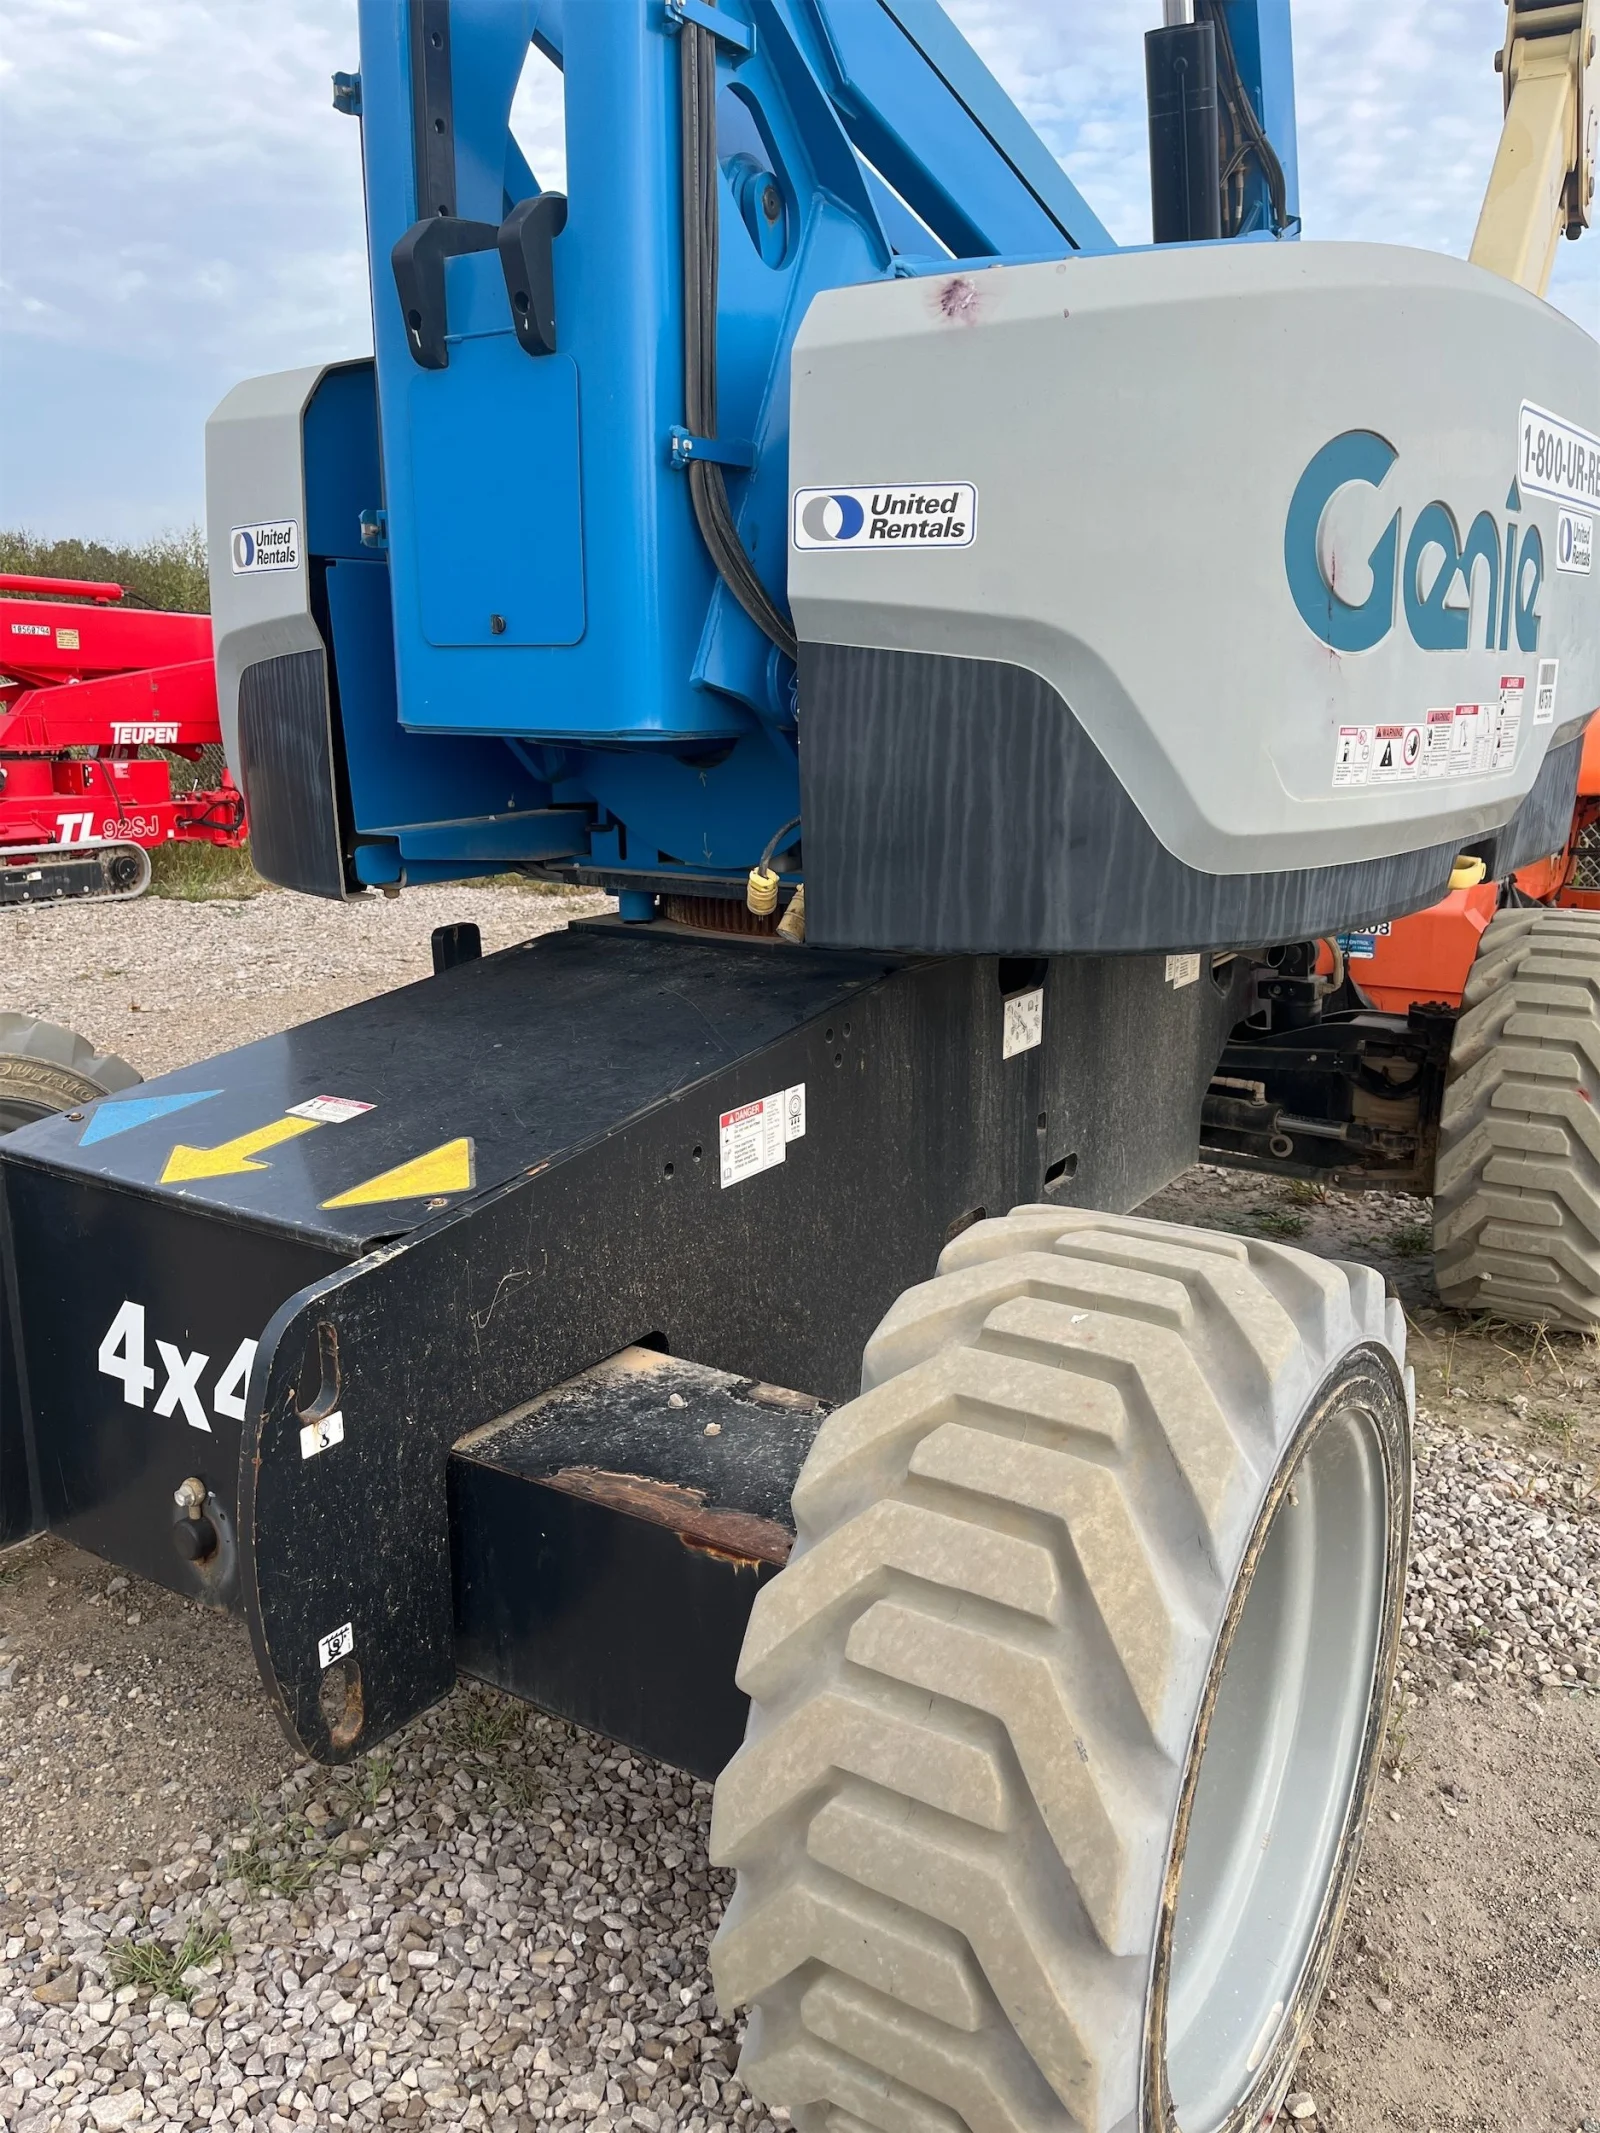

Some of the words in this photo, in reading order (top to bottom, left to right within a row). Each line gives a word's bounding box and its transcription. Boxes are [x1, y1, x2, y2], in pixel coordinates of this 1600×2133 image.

[871, 492, 959, 515] United
[256, 527, 291, 546] United
[869, 517, 966, 539] Rentals
[1573, 521, 1591, 544] United
[1284, 429, 1544, 652] Genie
[257, 546, 296, 565] Rentals
[1572, 544, 1591, 567] Rentals
[110, 722, 179, 744] TEUPEN
[56, 812, 103, 844] TL
[103, 815, 159, 839] 92SJ
[735, 1104, 760, 1121] DANGER
[98, 1300, 260, 1433] 4x4
